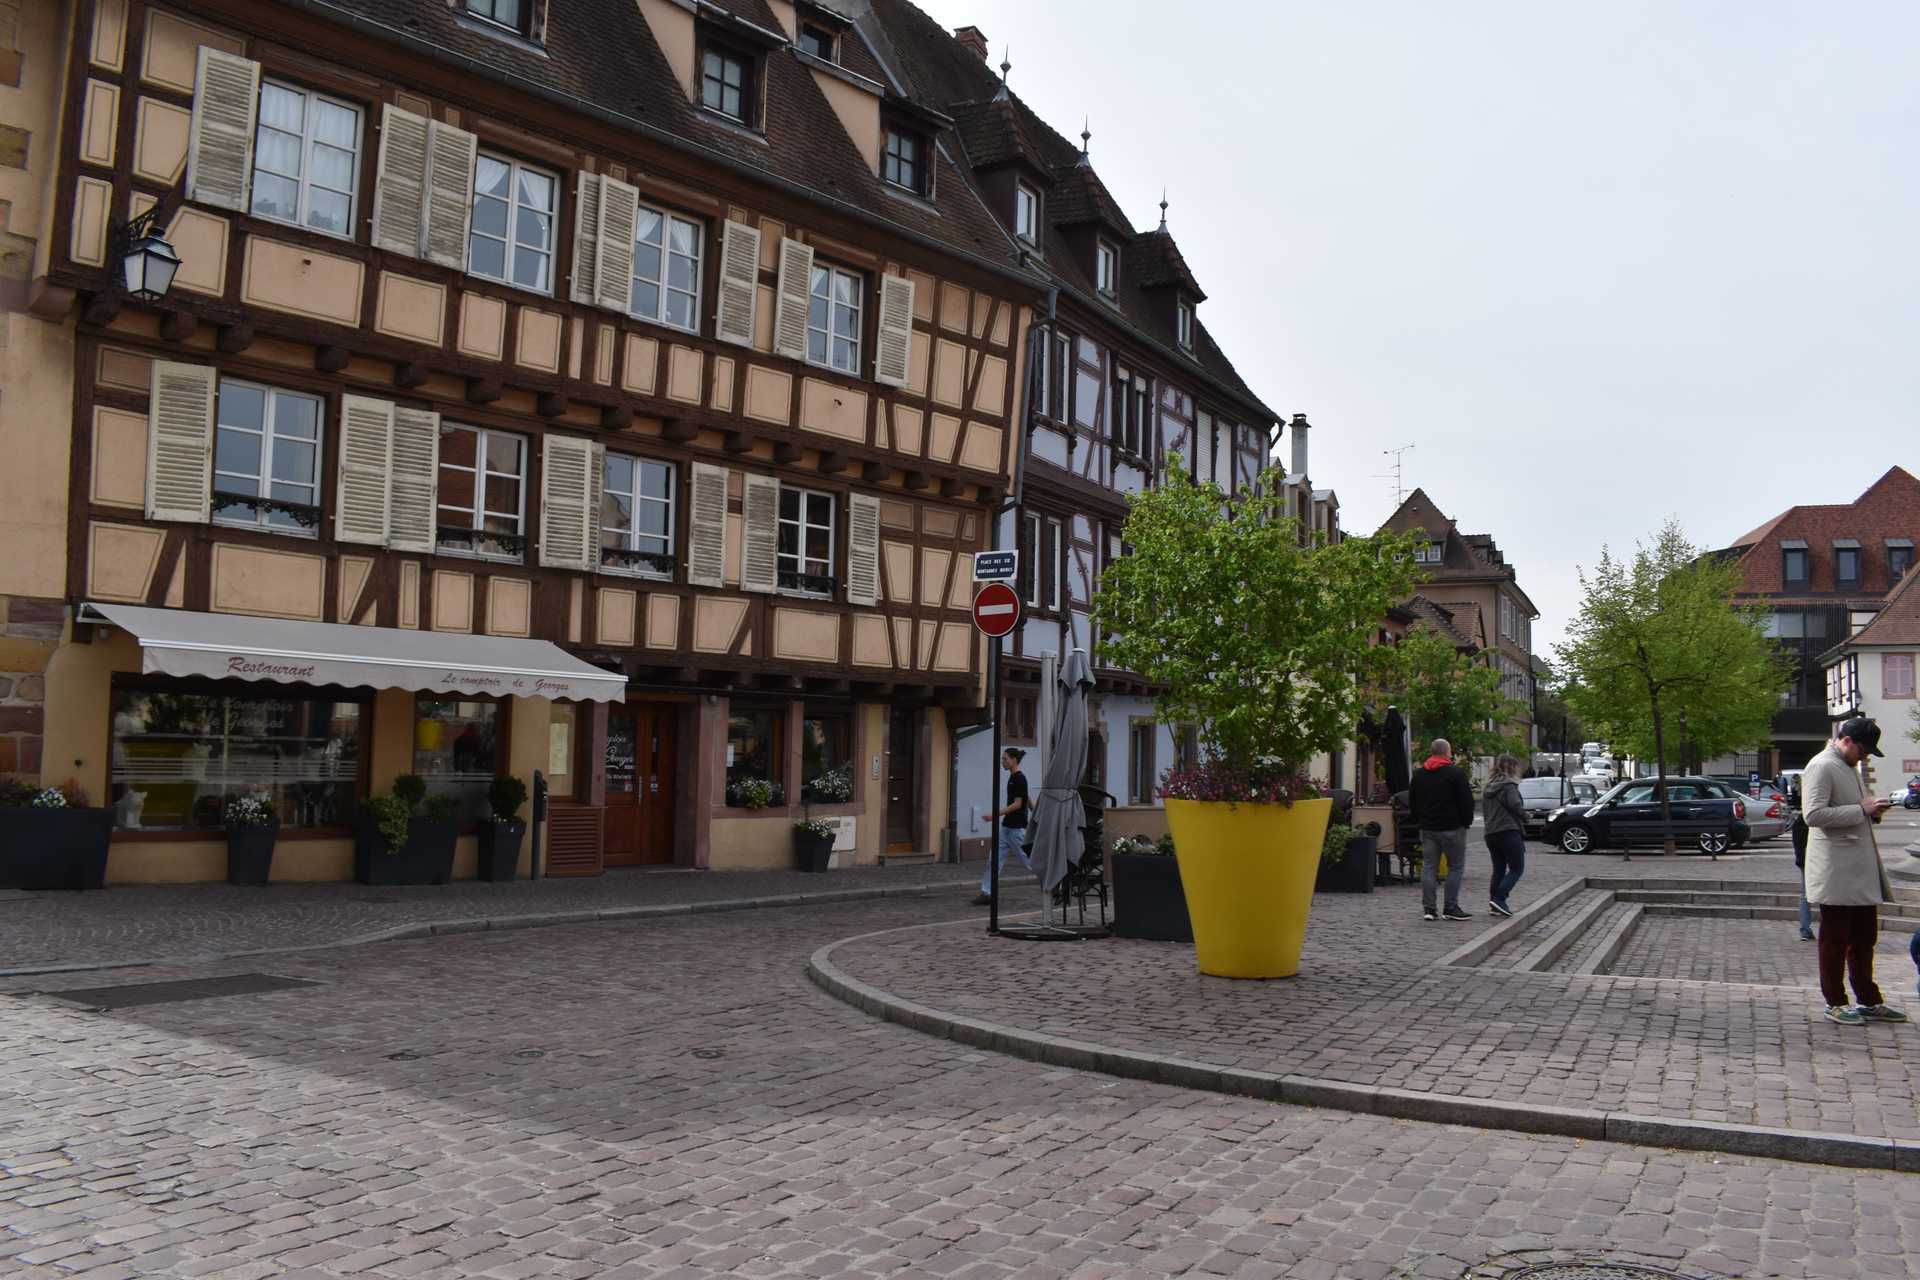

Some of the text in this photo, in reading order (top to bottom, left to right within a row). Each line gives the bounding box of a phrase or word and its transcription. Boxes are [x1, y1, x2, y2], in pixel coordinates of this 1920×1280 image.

[226, 656, 315, 677] Restaurant
[440, 673, 456, 684] Le
[512, 678, 525, 688] de
[535, 678, 568, 692] Georges
[1751, 774, 1759, 782] P
